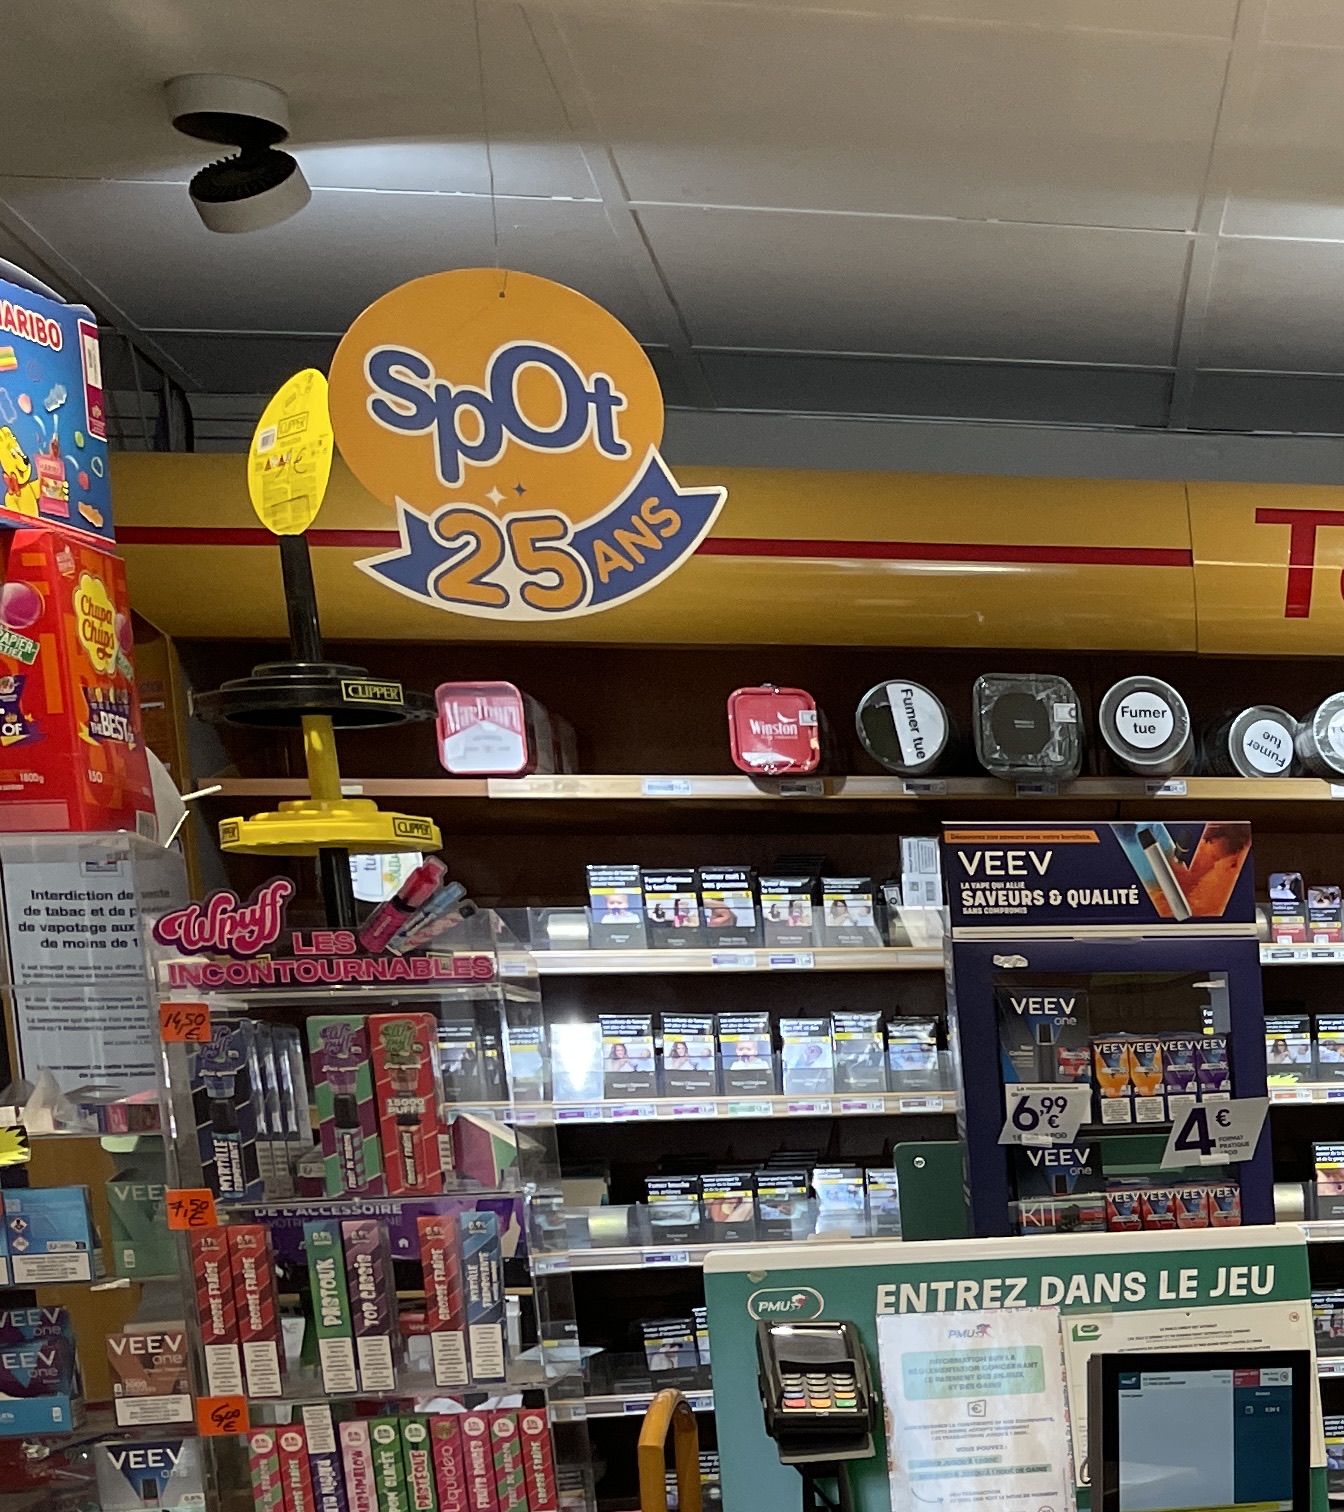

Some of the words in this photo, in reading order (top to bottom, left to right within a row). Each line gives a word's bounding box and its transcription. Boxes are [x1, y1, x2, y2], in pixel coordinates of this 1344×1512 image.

[432, 507, 590, 610] 25
[593, 497, 681, 583] ANS
[901, 688, 919, 732] Fumer
[1120, 706, 1168, 721] Fumer
[2, 723, 22, 735] OF
[749, 719, 798, 735] Winston
[1133, 721, 1156, 735] tue
[909, 733, 926, 760] tue
[957, 850, 1053, 876] VEEV
[30, 888, 112, 902] Interdiction
[115, 888, 134, 902] de
[961, 889, 1045, 907] SAVEURS
[1049, 889, 1062, 906] &
[1067, 885, 1140, 908] QUALITÉ
[293, 931, 356, 955] LES
[165, 1011, 206, 1036] 14,50
[1173, 1106, 1217, 1157] 4
[1215, 1108, 1232, 1128] €
[877, 1276, 1029, 1315] ENTREZ
[1039, 1271, 1147, 1307] DANS
[1159, 1268, 1200, 1300] LE
[1210, 1264, 1276, 1298] JEU
[440, 1444, 463, 1512] Liquideo
